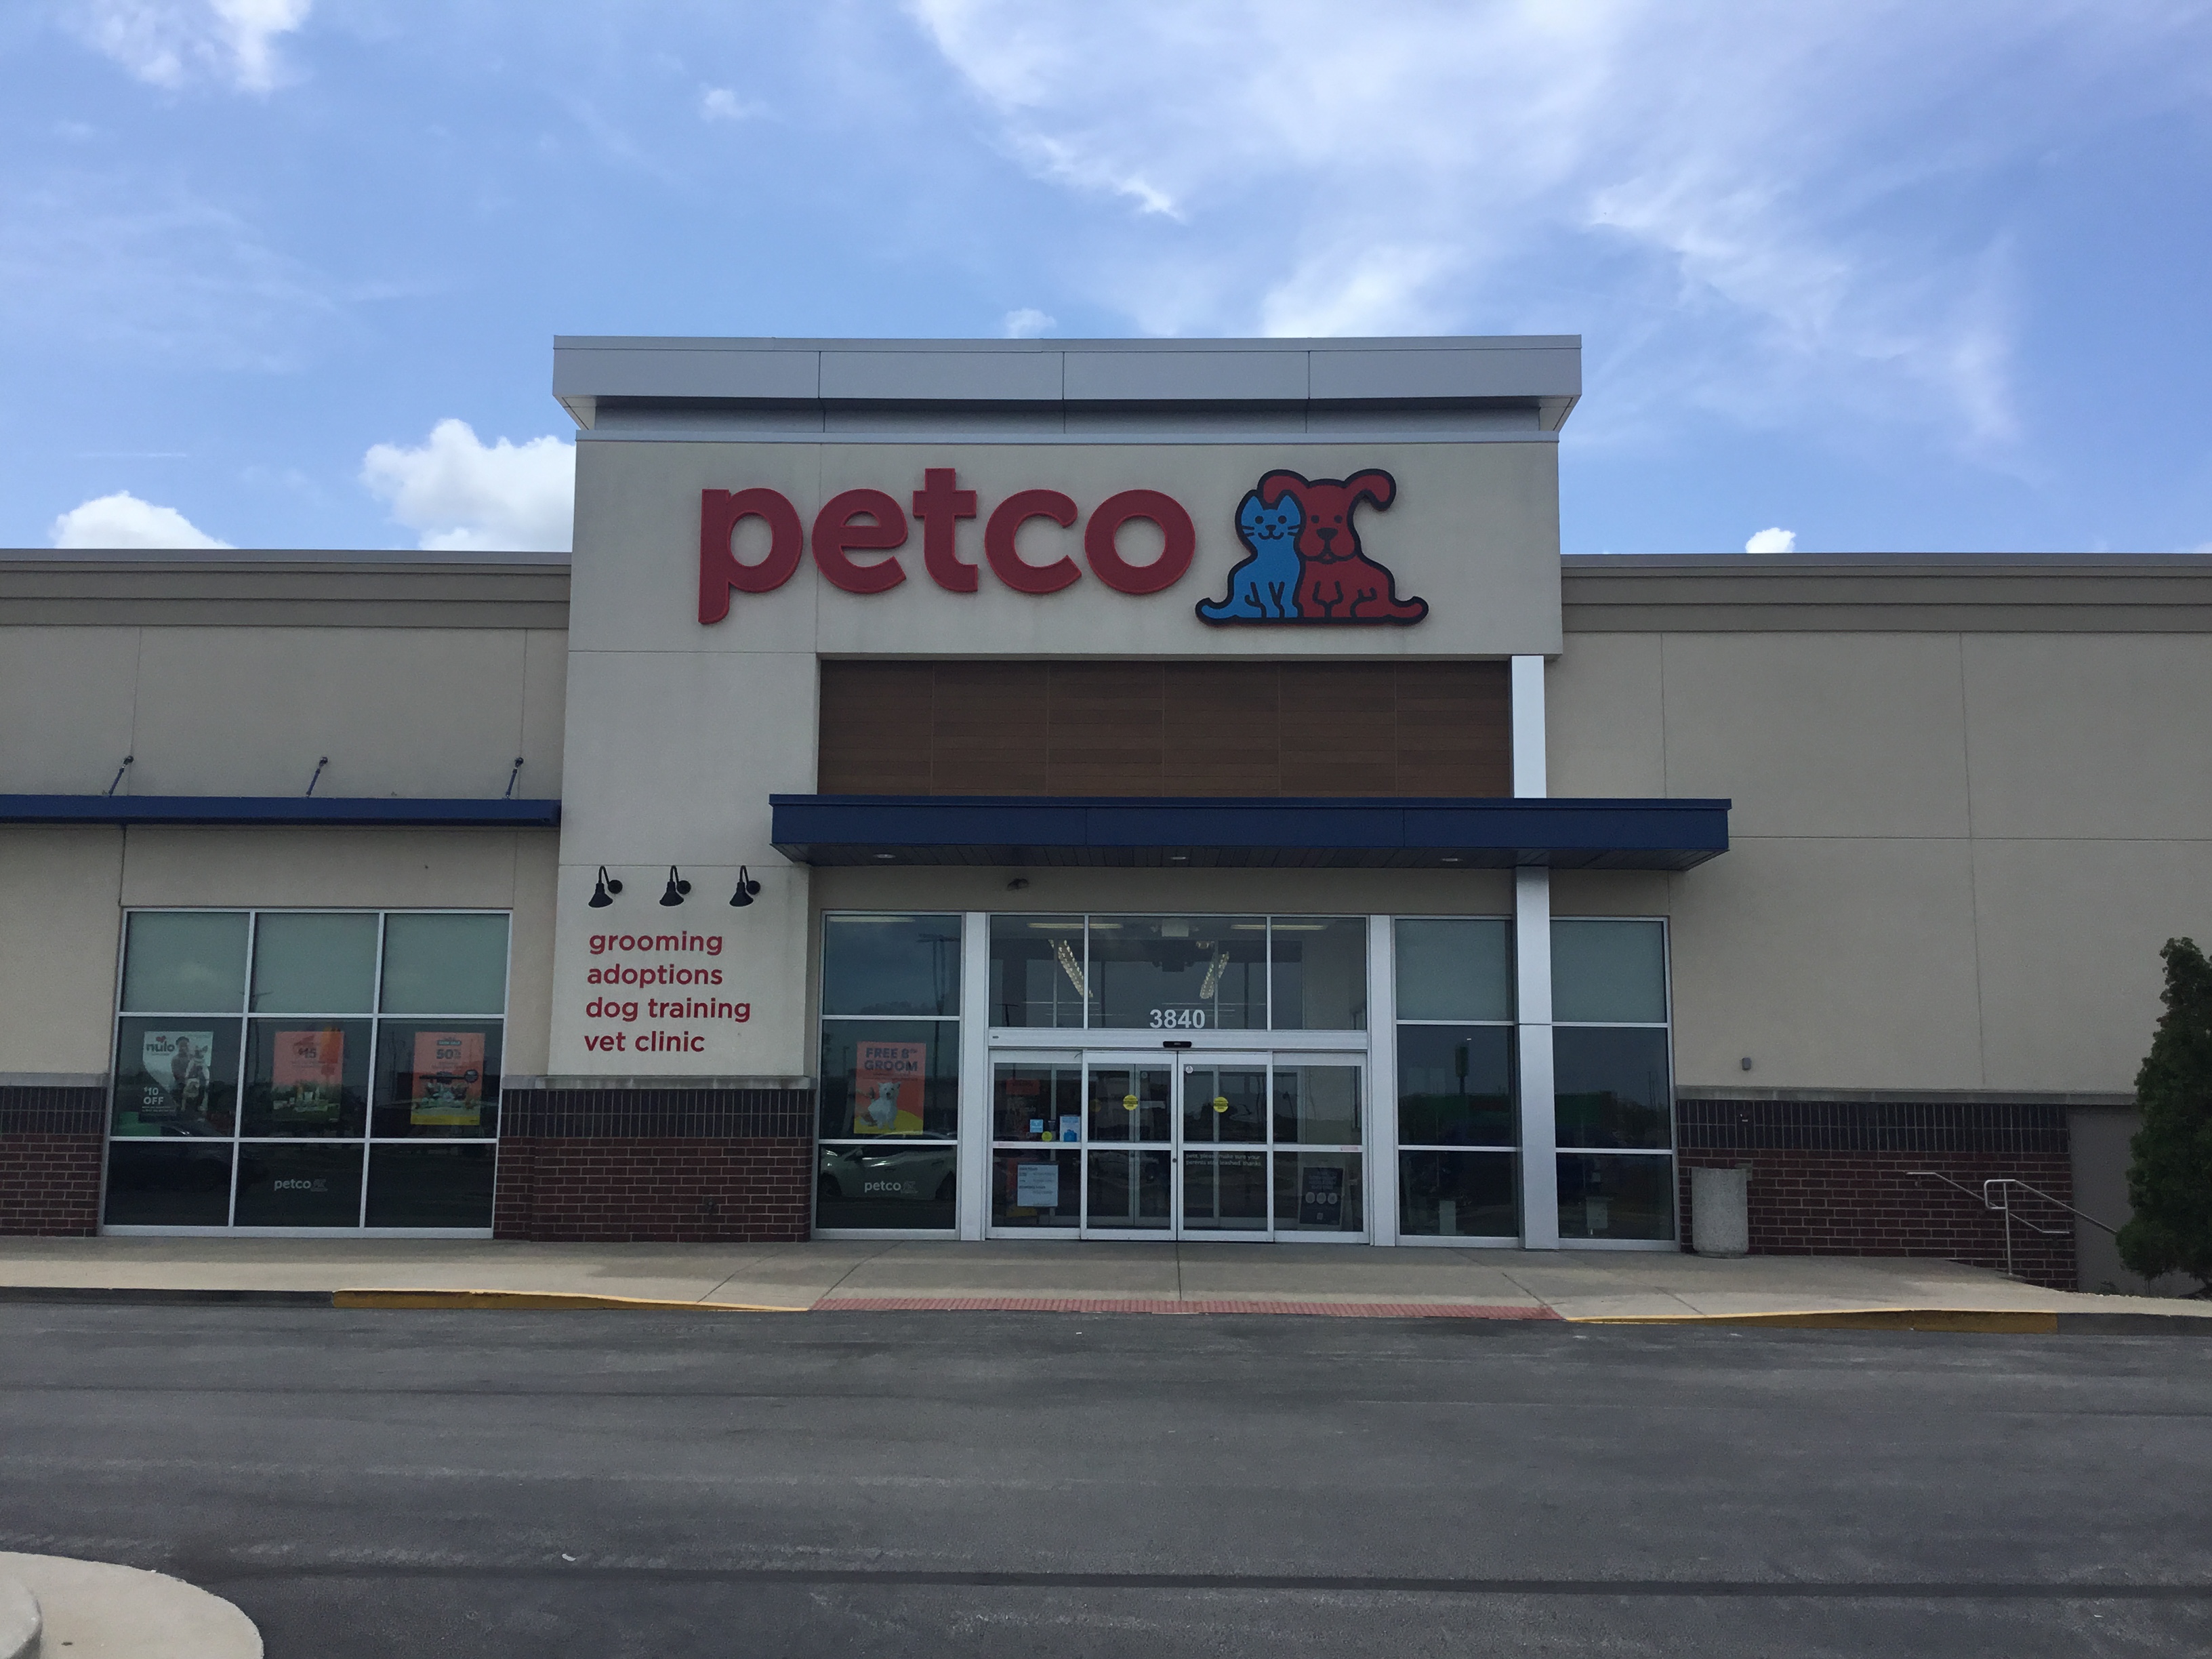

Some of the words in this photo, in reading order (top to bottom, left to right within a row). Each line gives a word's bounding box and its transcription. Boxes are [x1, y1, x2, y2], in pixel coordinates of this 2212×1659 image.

[698, 468, 1196, 625] petco
[589, 930, 723, 956] grooming
[587, 964, 723, 988] adoptions
[586, 997, 638, 1022] dog
[648, 998, 751, 1023] training
[1149, 1008, 1206, 1029] 3840
[146, 1041, 176, 1052] nulo
[584, 1031, 626, 1052] vet
[635, 1031, 705, 1052] clinic
[865, 1047, 898, 1059] FREE
[864, 1060, 918, 1071] GROOM
[144, 1086, 159, 1096] $10
[143, 1097, 164, 1105] OFF
[274, 1179, 311, 1191] petco
[864, 1181, 901, 1193] petco
